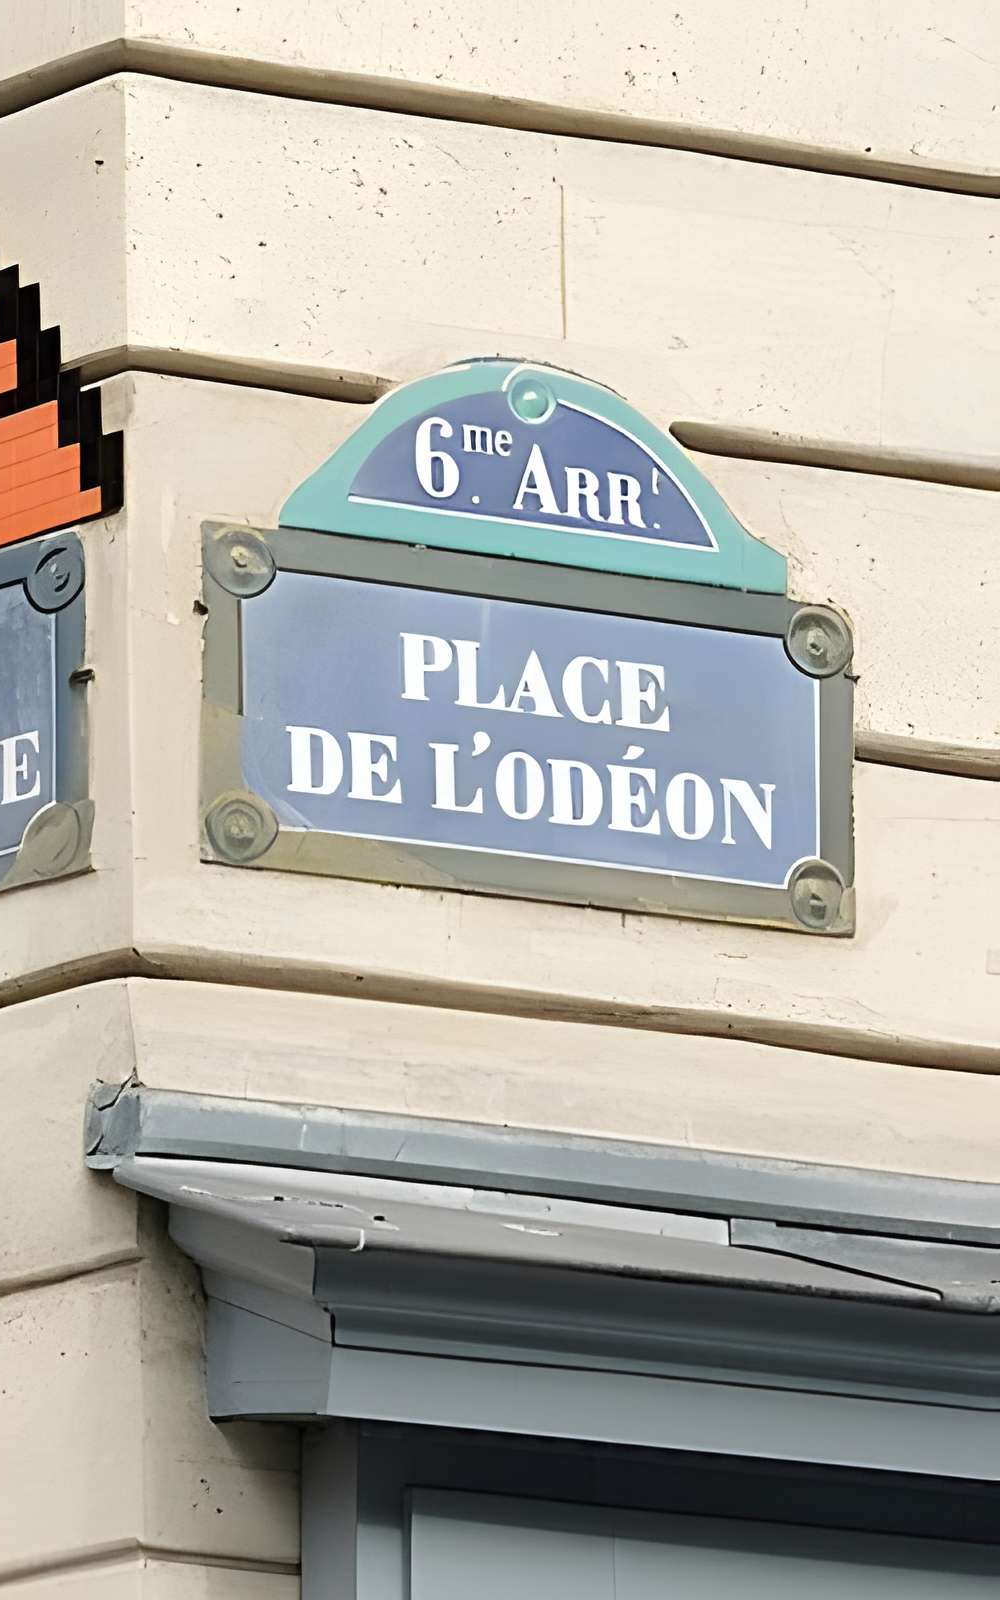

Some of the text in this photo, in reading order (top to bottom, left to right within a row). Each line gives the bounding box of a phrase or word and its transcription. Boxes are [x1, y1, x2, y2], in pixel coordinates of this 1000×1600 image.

[400, 632, 671, 732] PLACE
[285, 726, 776, 849] DE L'ODÉON
